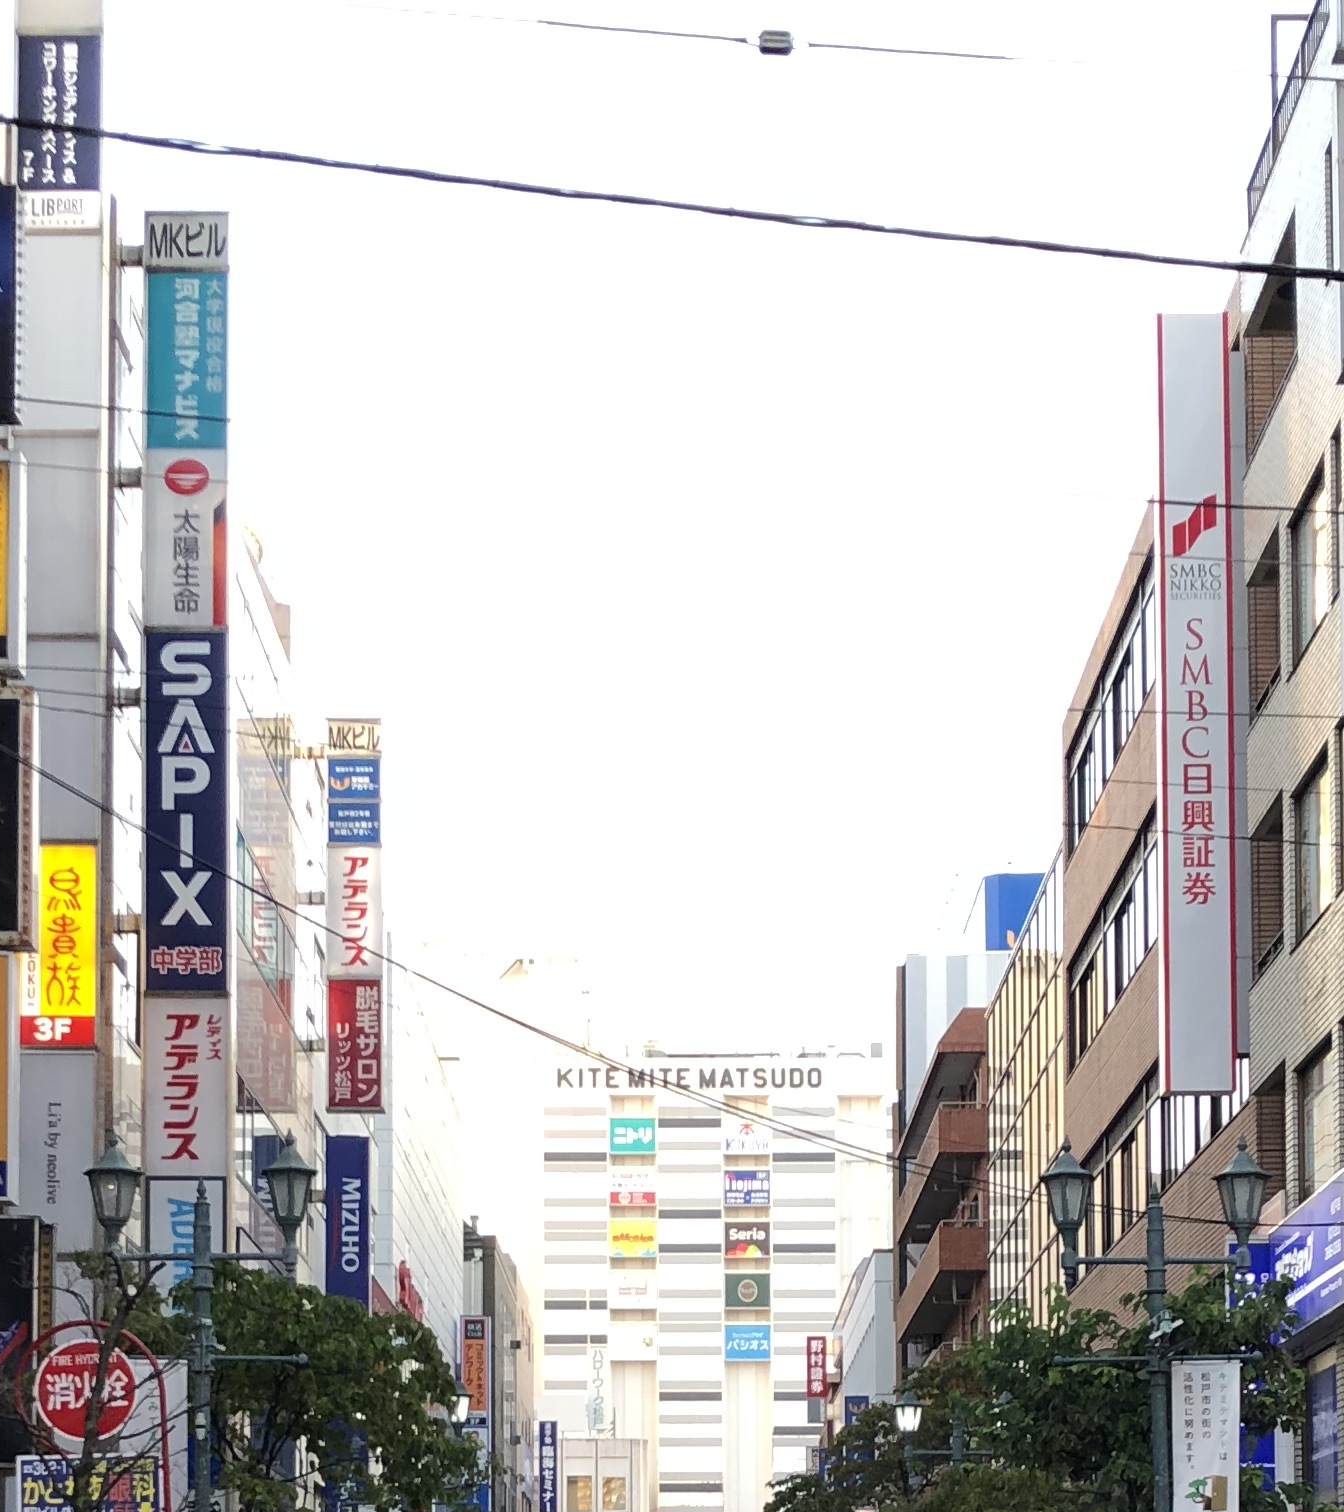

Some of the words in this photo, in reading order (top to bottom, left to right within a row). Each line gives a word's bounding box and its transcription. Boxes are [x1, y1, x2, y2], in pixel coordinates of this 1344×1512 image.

[149, 222, 227, 259] MKビル
[173, 508, 201, 614] 太陽生命
[1170, 563, 1222, 579] SMBC
[1170, 579, 1222, 592] NIKKO
[1170, 592, 1222, 600] SECURITIES
[329, 725, 380, 750] MKビル
[1180, 617, 1216, 905] SMBC日興証券
[156, 639, 215, 927] SAPIX
[341, 857, 369, 968] アデランス
[150, 947, 223, 975] 中学部
[32, 1016, 72, 1041] 3F
[355, 985, 380, 1102] 脱毛サロン
[334, 1022, 351, 1102] リッツ松戸
[557, 1068, 619, 1089] KITE
[628, 1068, 691, 1089] MITE
[699, 1068, 822, 1089] MATSUDO
[161, 1013, 200, 1163] アデランス
[613, 1127, 652, 1144] ニトリ
[341, 1177, 361, 1273] MIZUHO
[729, 1228, 765, 1240] Seria
[51, 1354, 73, 1366] FIRE
[727, 1339, 769, 1351] パシオス
[1184, 1372, 1195, 1469] 活性化に努めます。
[1201, 1372, 1211, 1439] 松戸市の街の
[1219, 1372, 1228, 1460] キテミテマツドは
[542, 1446, 554, 1512] 臨海セミナー
